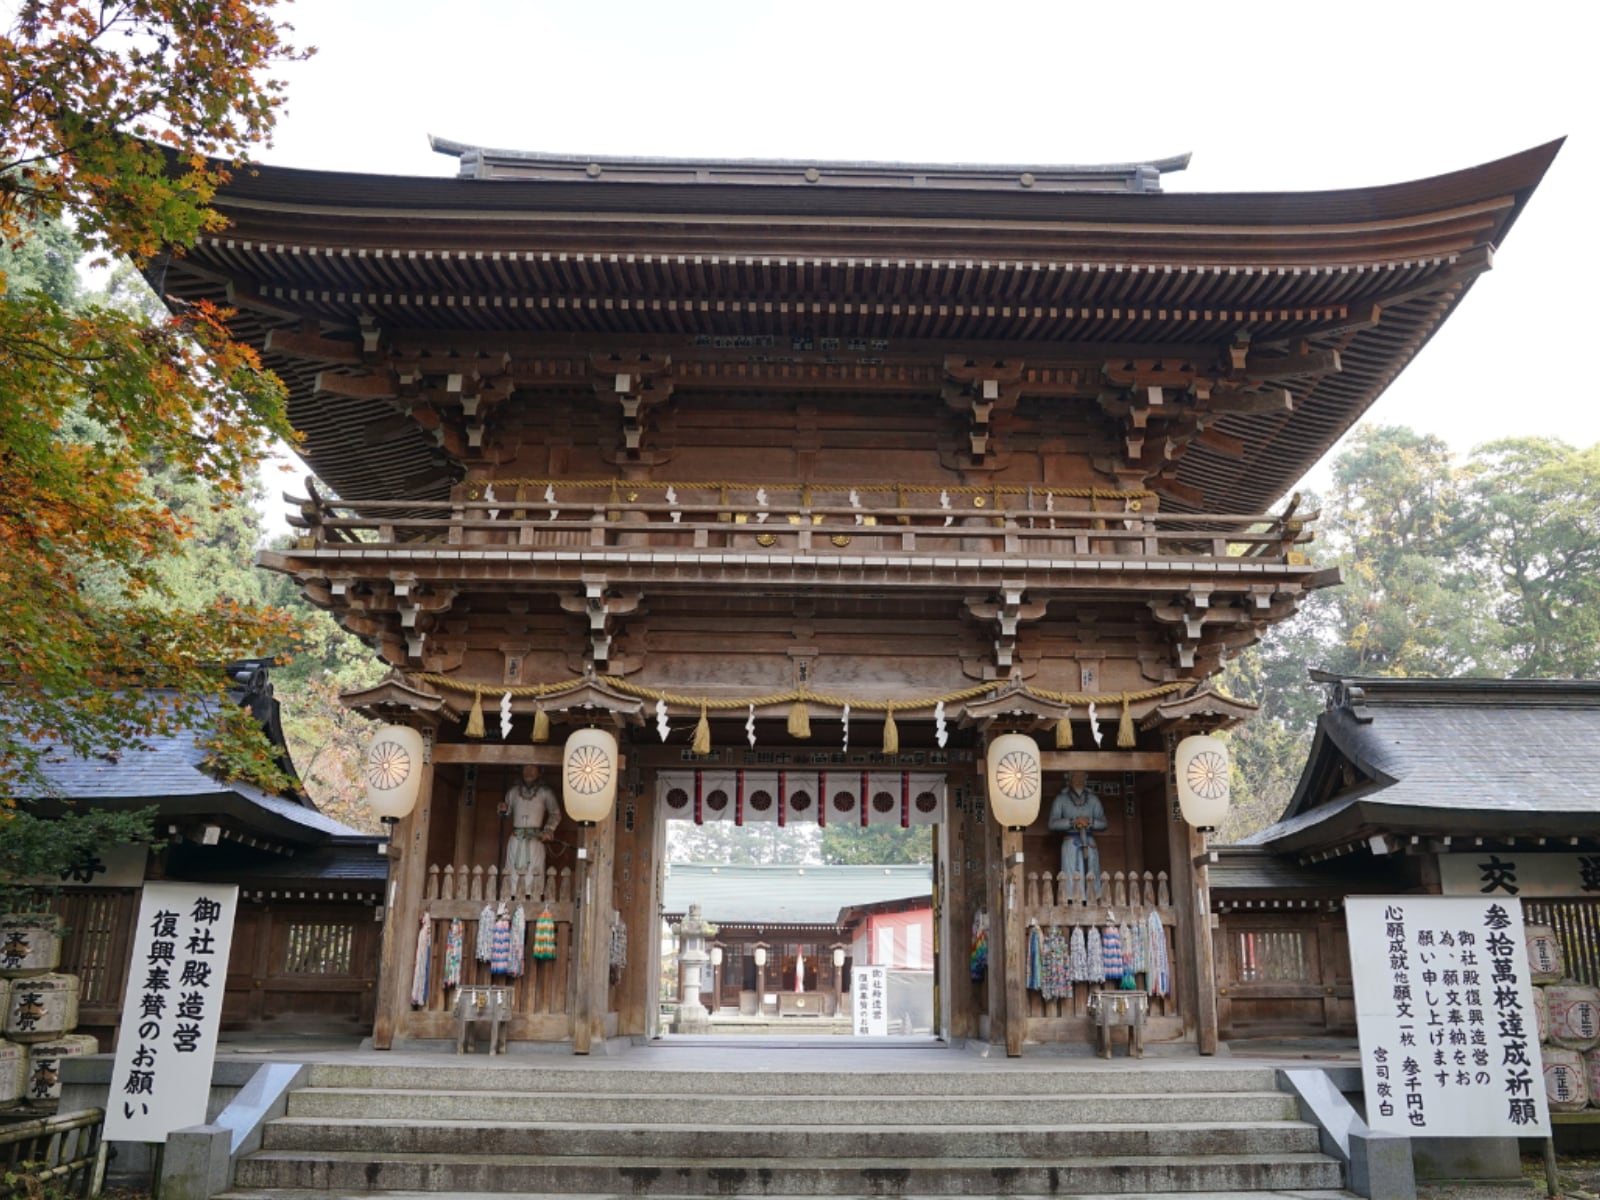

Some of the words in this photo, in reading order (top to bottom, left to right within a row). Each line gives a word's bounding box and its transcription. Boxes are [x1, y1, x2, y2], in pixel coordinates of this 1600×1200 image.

[123, 909, 181, 1120] 復興奉賛のお願い
[172, 896, 221, 1053] 御社殿造営
[1417, 929, 1450, 1088] 願い申し上げます
[1438, 930, 1471, 1086] 為、願文奉納をお
[1457, 929, 1491, 1086] 御社殿復興造営の
[1483, 903, 1539, 1125] 参拾萬枚達成祈願
[1373, 1046, 1394, 1117] 宮司敬白
[1401, 1056, 1426, 1127] 参千円也
